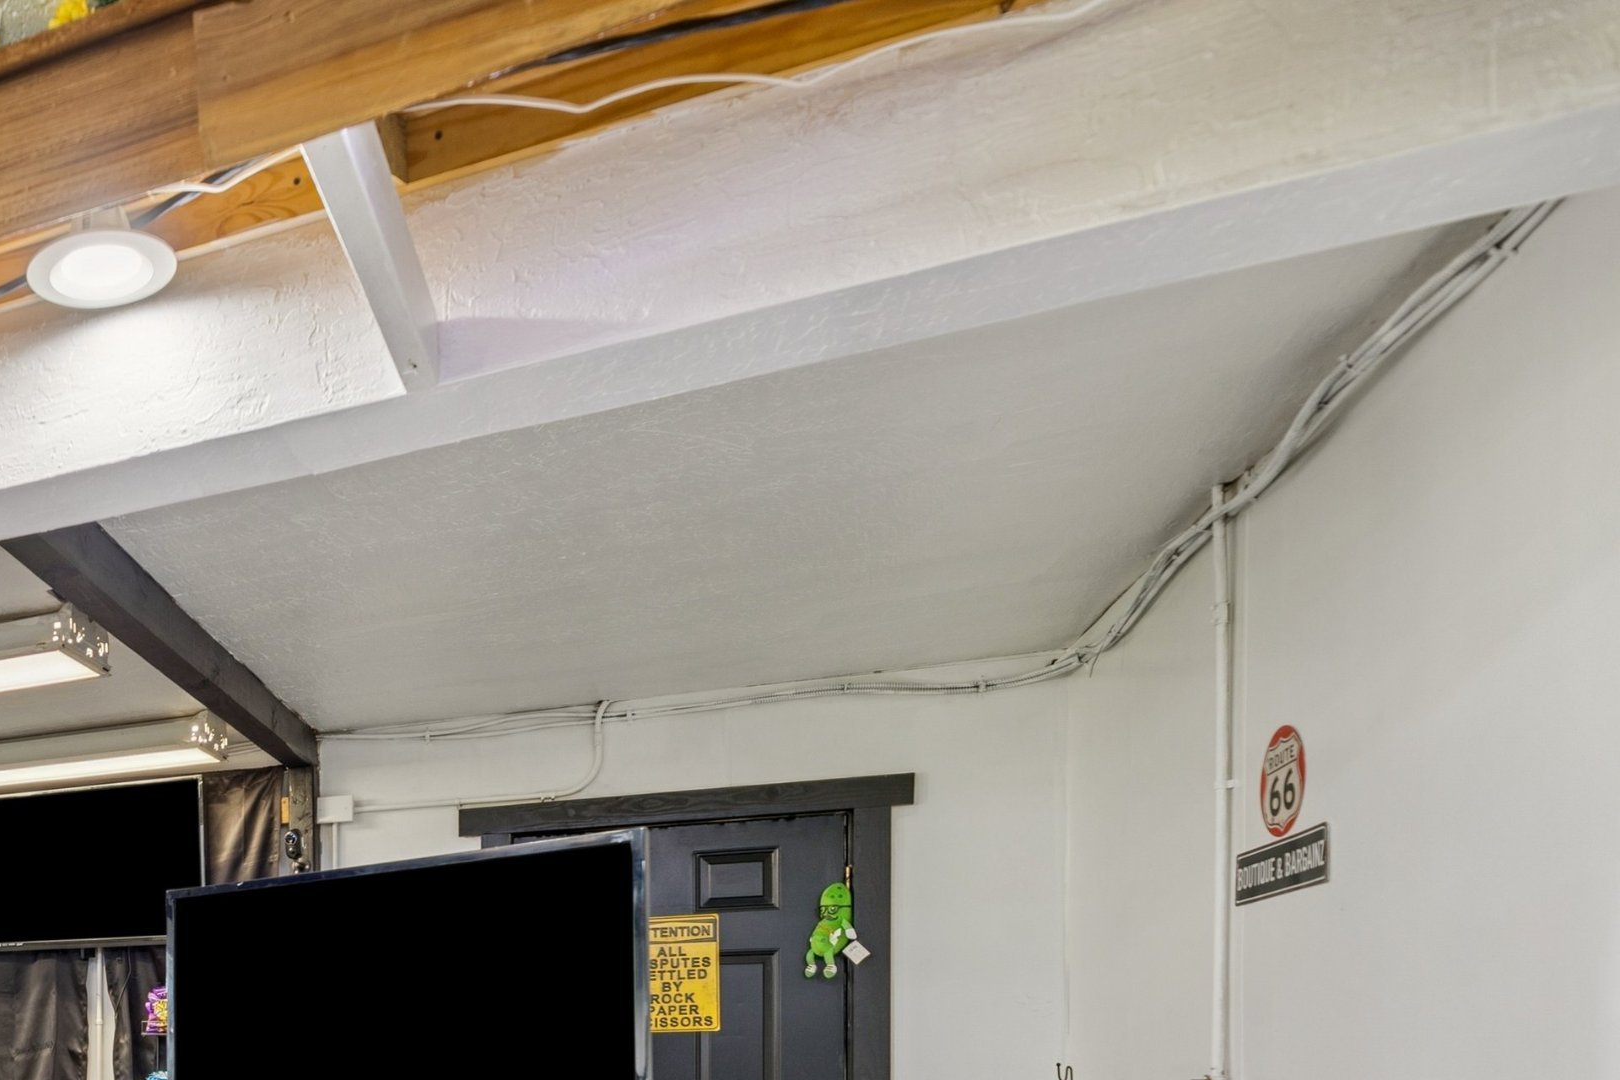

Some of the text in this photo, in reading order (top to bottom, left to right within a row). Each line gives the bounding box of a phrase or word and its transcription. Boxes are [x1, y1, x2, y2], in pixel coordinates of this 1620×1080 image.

[1267, 744, 1296, 770] ROUTE
[1269, 768, 1296, 817] 66
[1237, 840, 1326, 891] BOUTIQUE & BARGAINZ
[650, 925, 711, 938] TENTION
[657, 946, 687, 958] ALL
[650, 956, 711, 969] SPUTES
[650, 969, 708, 981] ETTLED
[661, 981, 683, 992] BY
[651, 992, 695, 1004] ROCK
[650, 1016, 714, 1028] ISSORS
